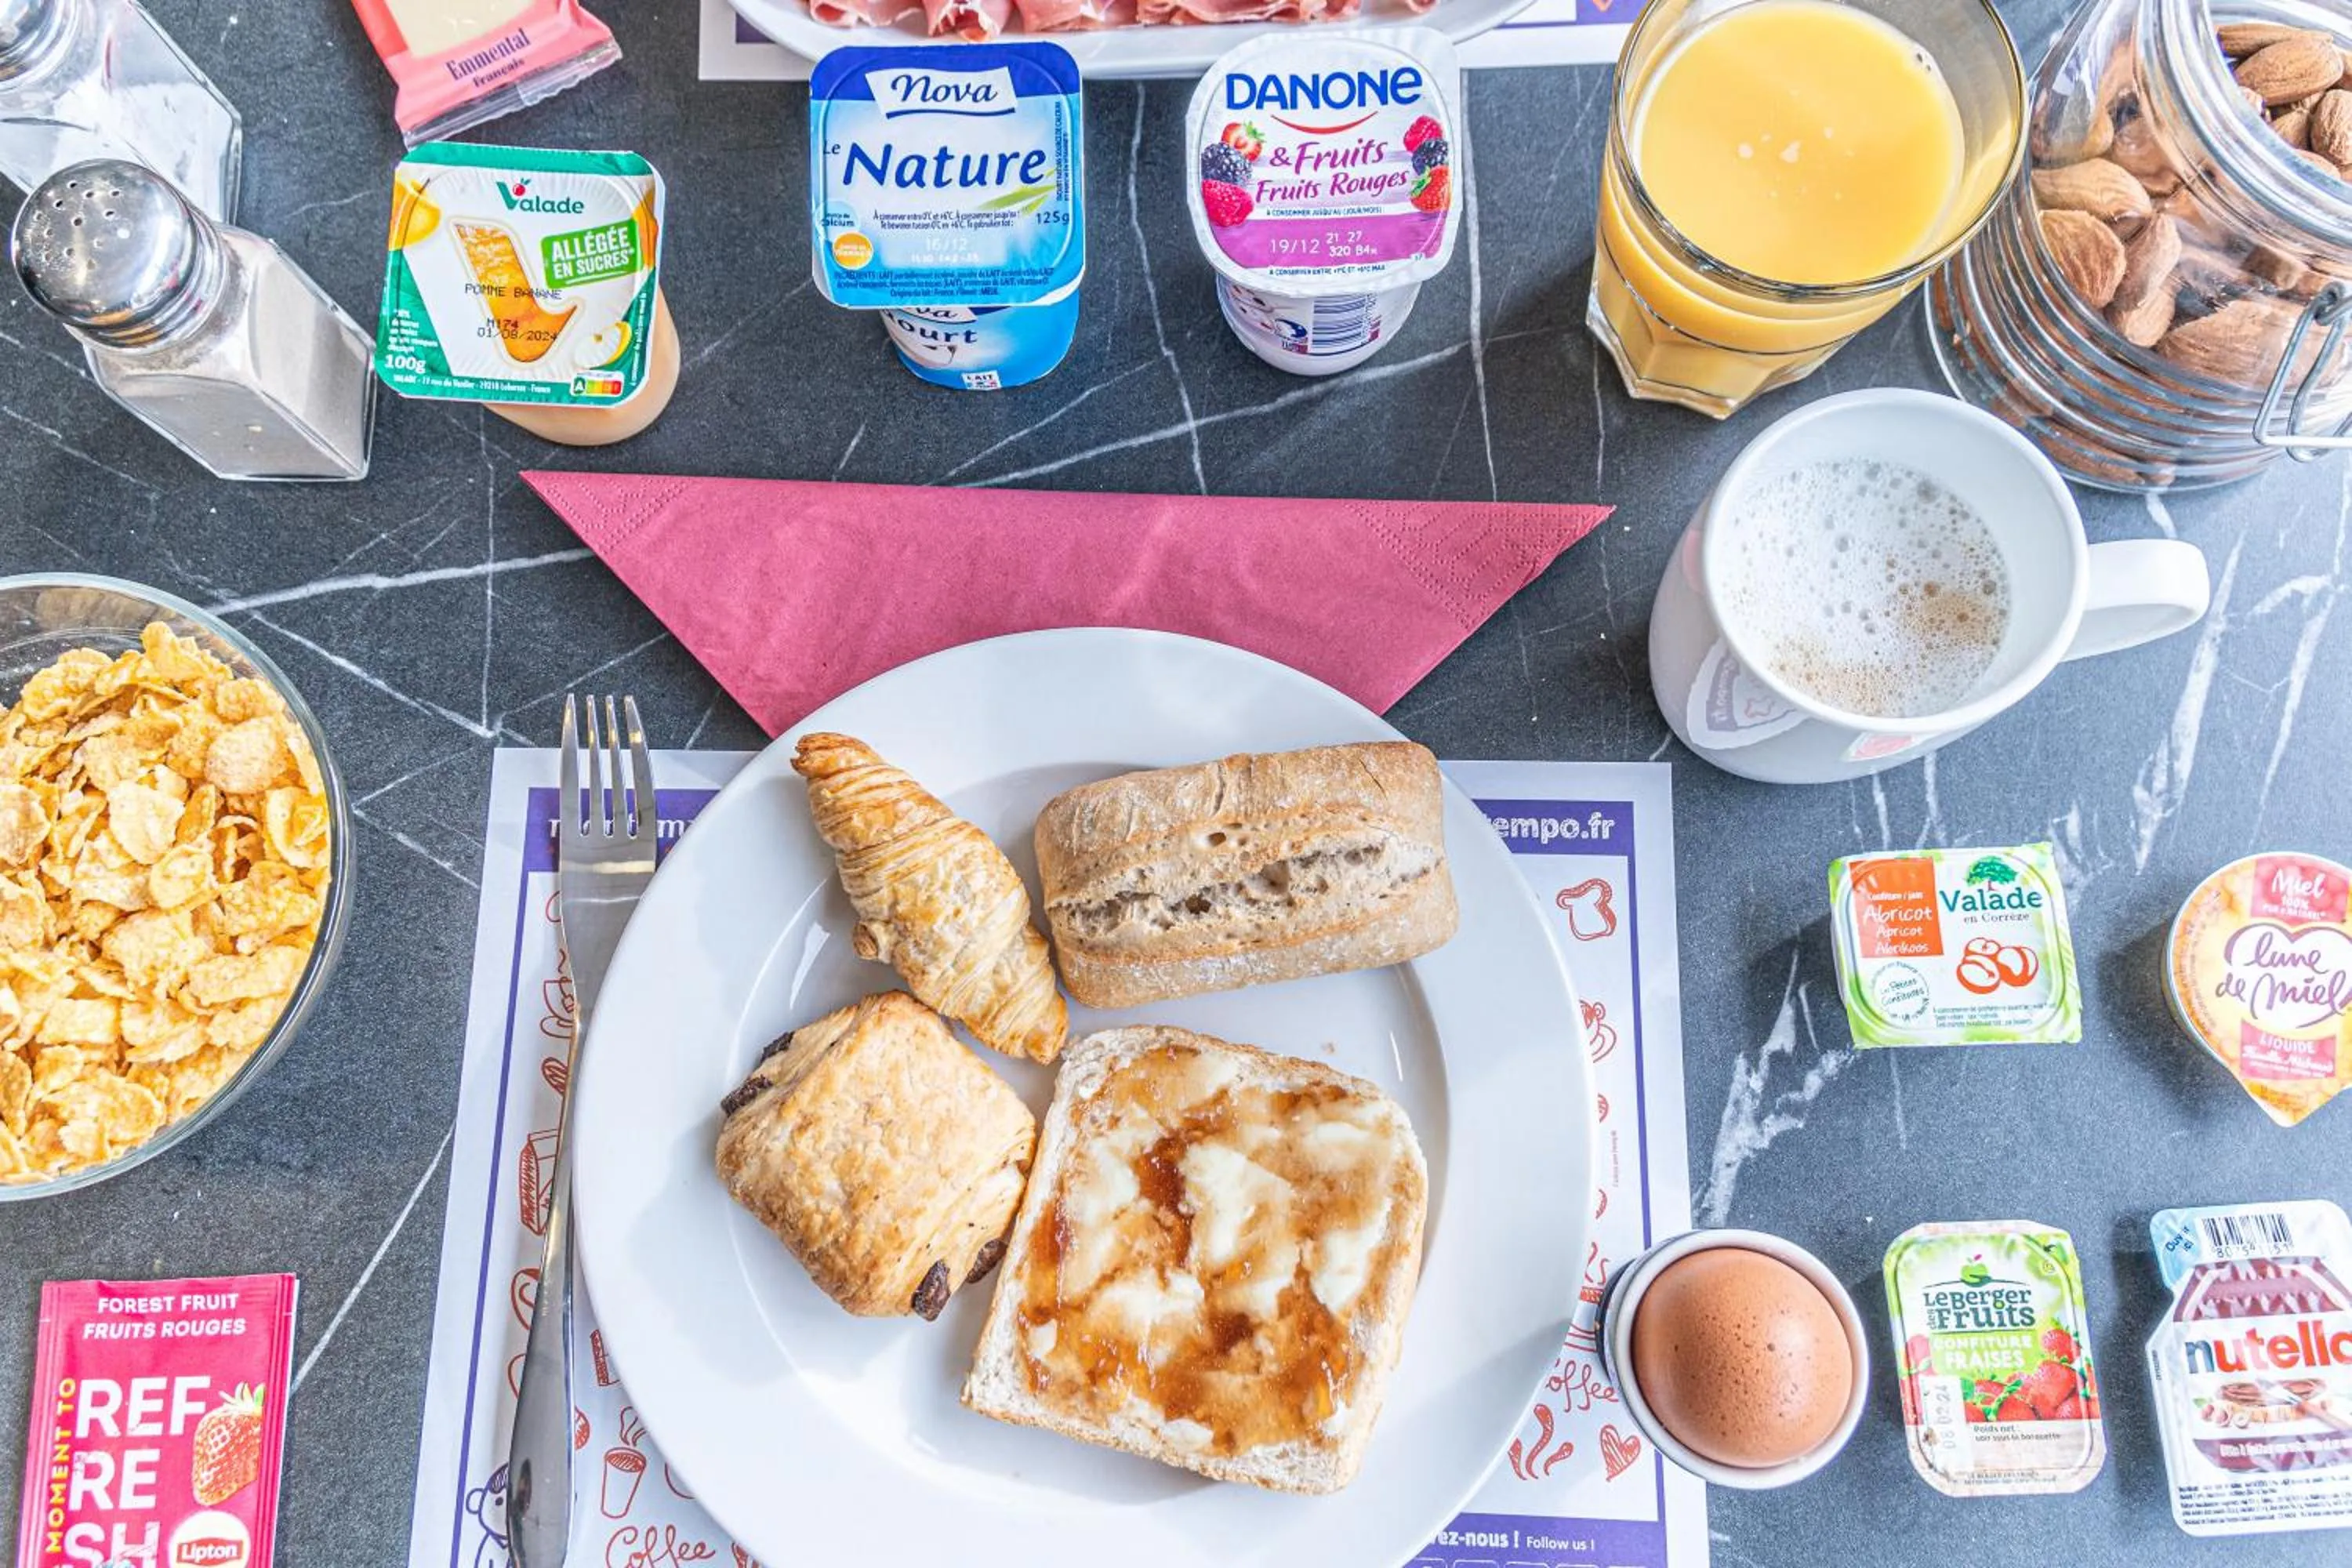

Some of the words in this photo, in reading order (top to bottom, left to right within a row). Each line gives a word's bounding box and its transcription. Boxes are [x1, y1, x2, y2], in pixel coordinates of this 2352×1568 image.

[445, 27, 531, 80] Emmental
[891, 74, 998, 103] Nova
[823, 140, 841, 154] Le
[843, 142, 1047, 188] Nature
[1270, 147, 1292, 167] &
[1295, 137, 1388, 175] Fruits
[496, 180, 584, 214] Valade
[1255, 179, 1319, 203] Fruits
[1330, 169, 1410, 197] Rouges
[1036, 211, 1069, 225] 125g
[552, 226, 630, 262] ALLÉGÉE
[1270, 238, 1320, 255] 19/12
[554, 262, 573, 280] EN
[514, 287, 562, 300] BANANE
[477, 327, 557, 342] 01/08/2024
[385, 354, 426, 374] 100g
[1489, 811, 1615, 844] empo.fr
[2271, 868, 2325, 899] Miel
[1939, 887, 2042, 913] Valade
[1864, 903, 1932, 925] Abricot
[1876, 925, 1923, 941] Apricot
[2215, 972, 2246, 1003] de
[2259, 1033, 2315, 1054] LIQUIDE
[98, 1296, 176, 1314] FOREST
[181, 1294, 238, 1312] FRUIT
[1935, 1305, 2036, 1329] Fruits
[82, 1322, 156, 1340] FRUITS
[162, 1318, 246, 1338] ROUGES
[1932, 1335, 2033, 1351] CONFITURE
[1945, 1351, 2025, 1370] FRAISES
[56, 1377, 76, 1416] TO
[1545, 1359, 1619, 1413] offee
[75, 1375, 211, 1439] REF
[45, 1427, 72, 1552] MOMENT
[69, 1449, 160, 1512] RE
[64, 1521, 160, 1568] SH
[181, 1543, 239, 1563] Lipton
[606, 1524, 716, 1568] Coffee
[1527, 1536, 1569, 1550] Follow
[1572, 1541, 1588, 1551] us
